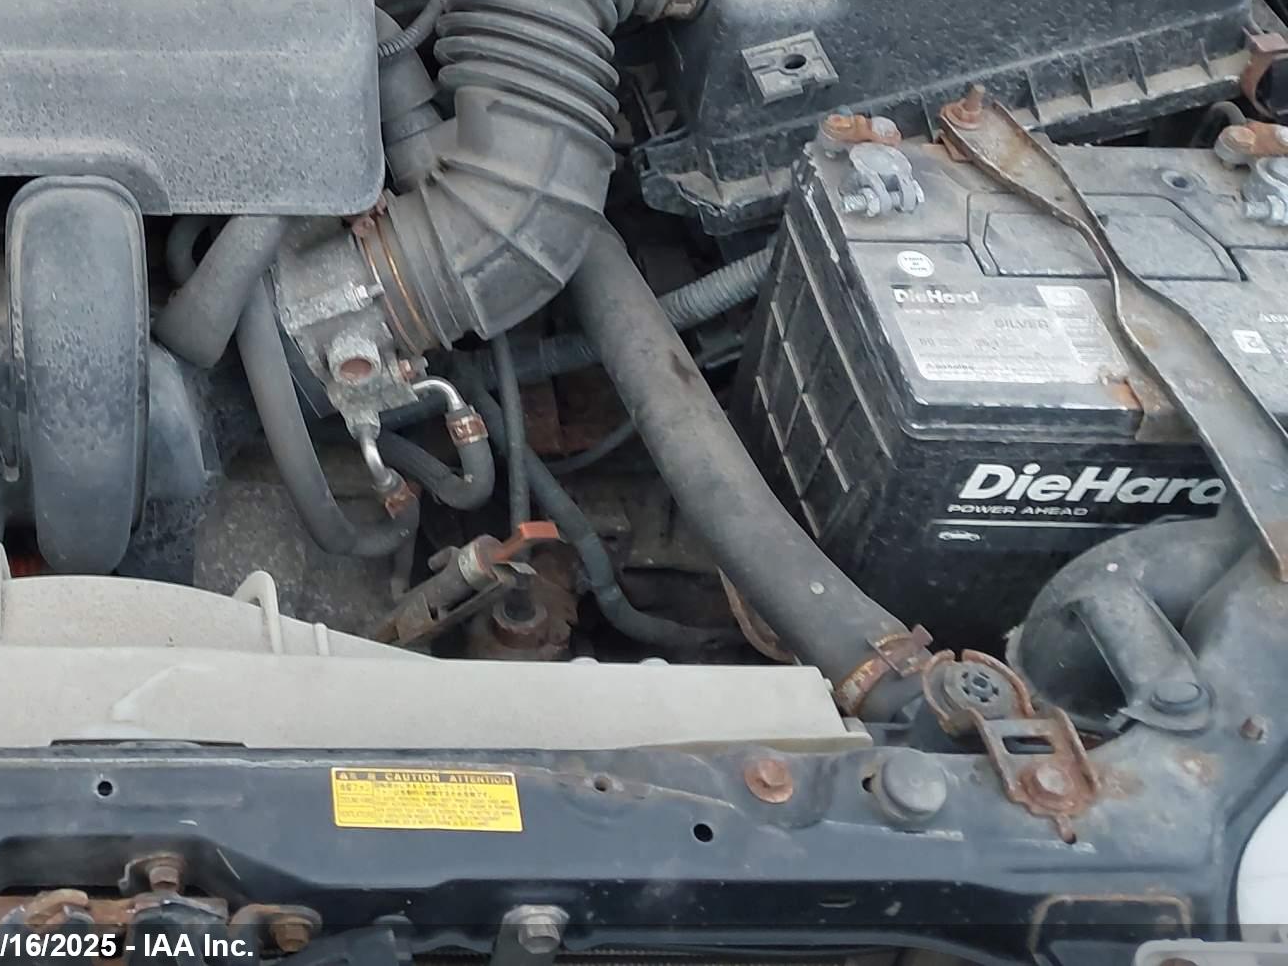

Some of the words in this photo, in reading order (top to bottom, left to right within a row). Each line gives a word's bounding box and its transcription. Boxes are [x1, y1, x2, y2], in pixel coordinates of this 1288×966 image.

[893, 288, 980, 305] DieHard
[994, 318, 1049, 330] SILVER
[947, 504, 1017, 516] POWER
[1020, 505, 1089, 517] AHEAD
[385, 773, 441, 783] CAUTION
[449, 774, 511, 785] ATTENTION
